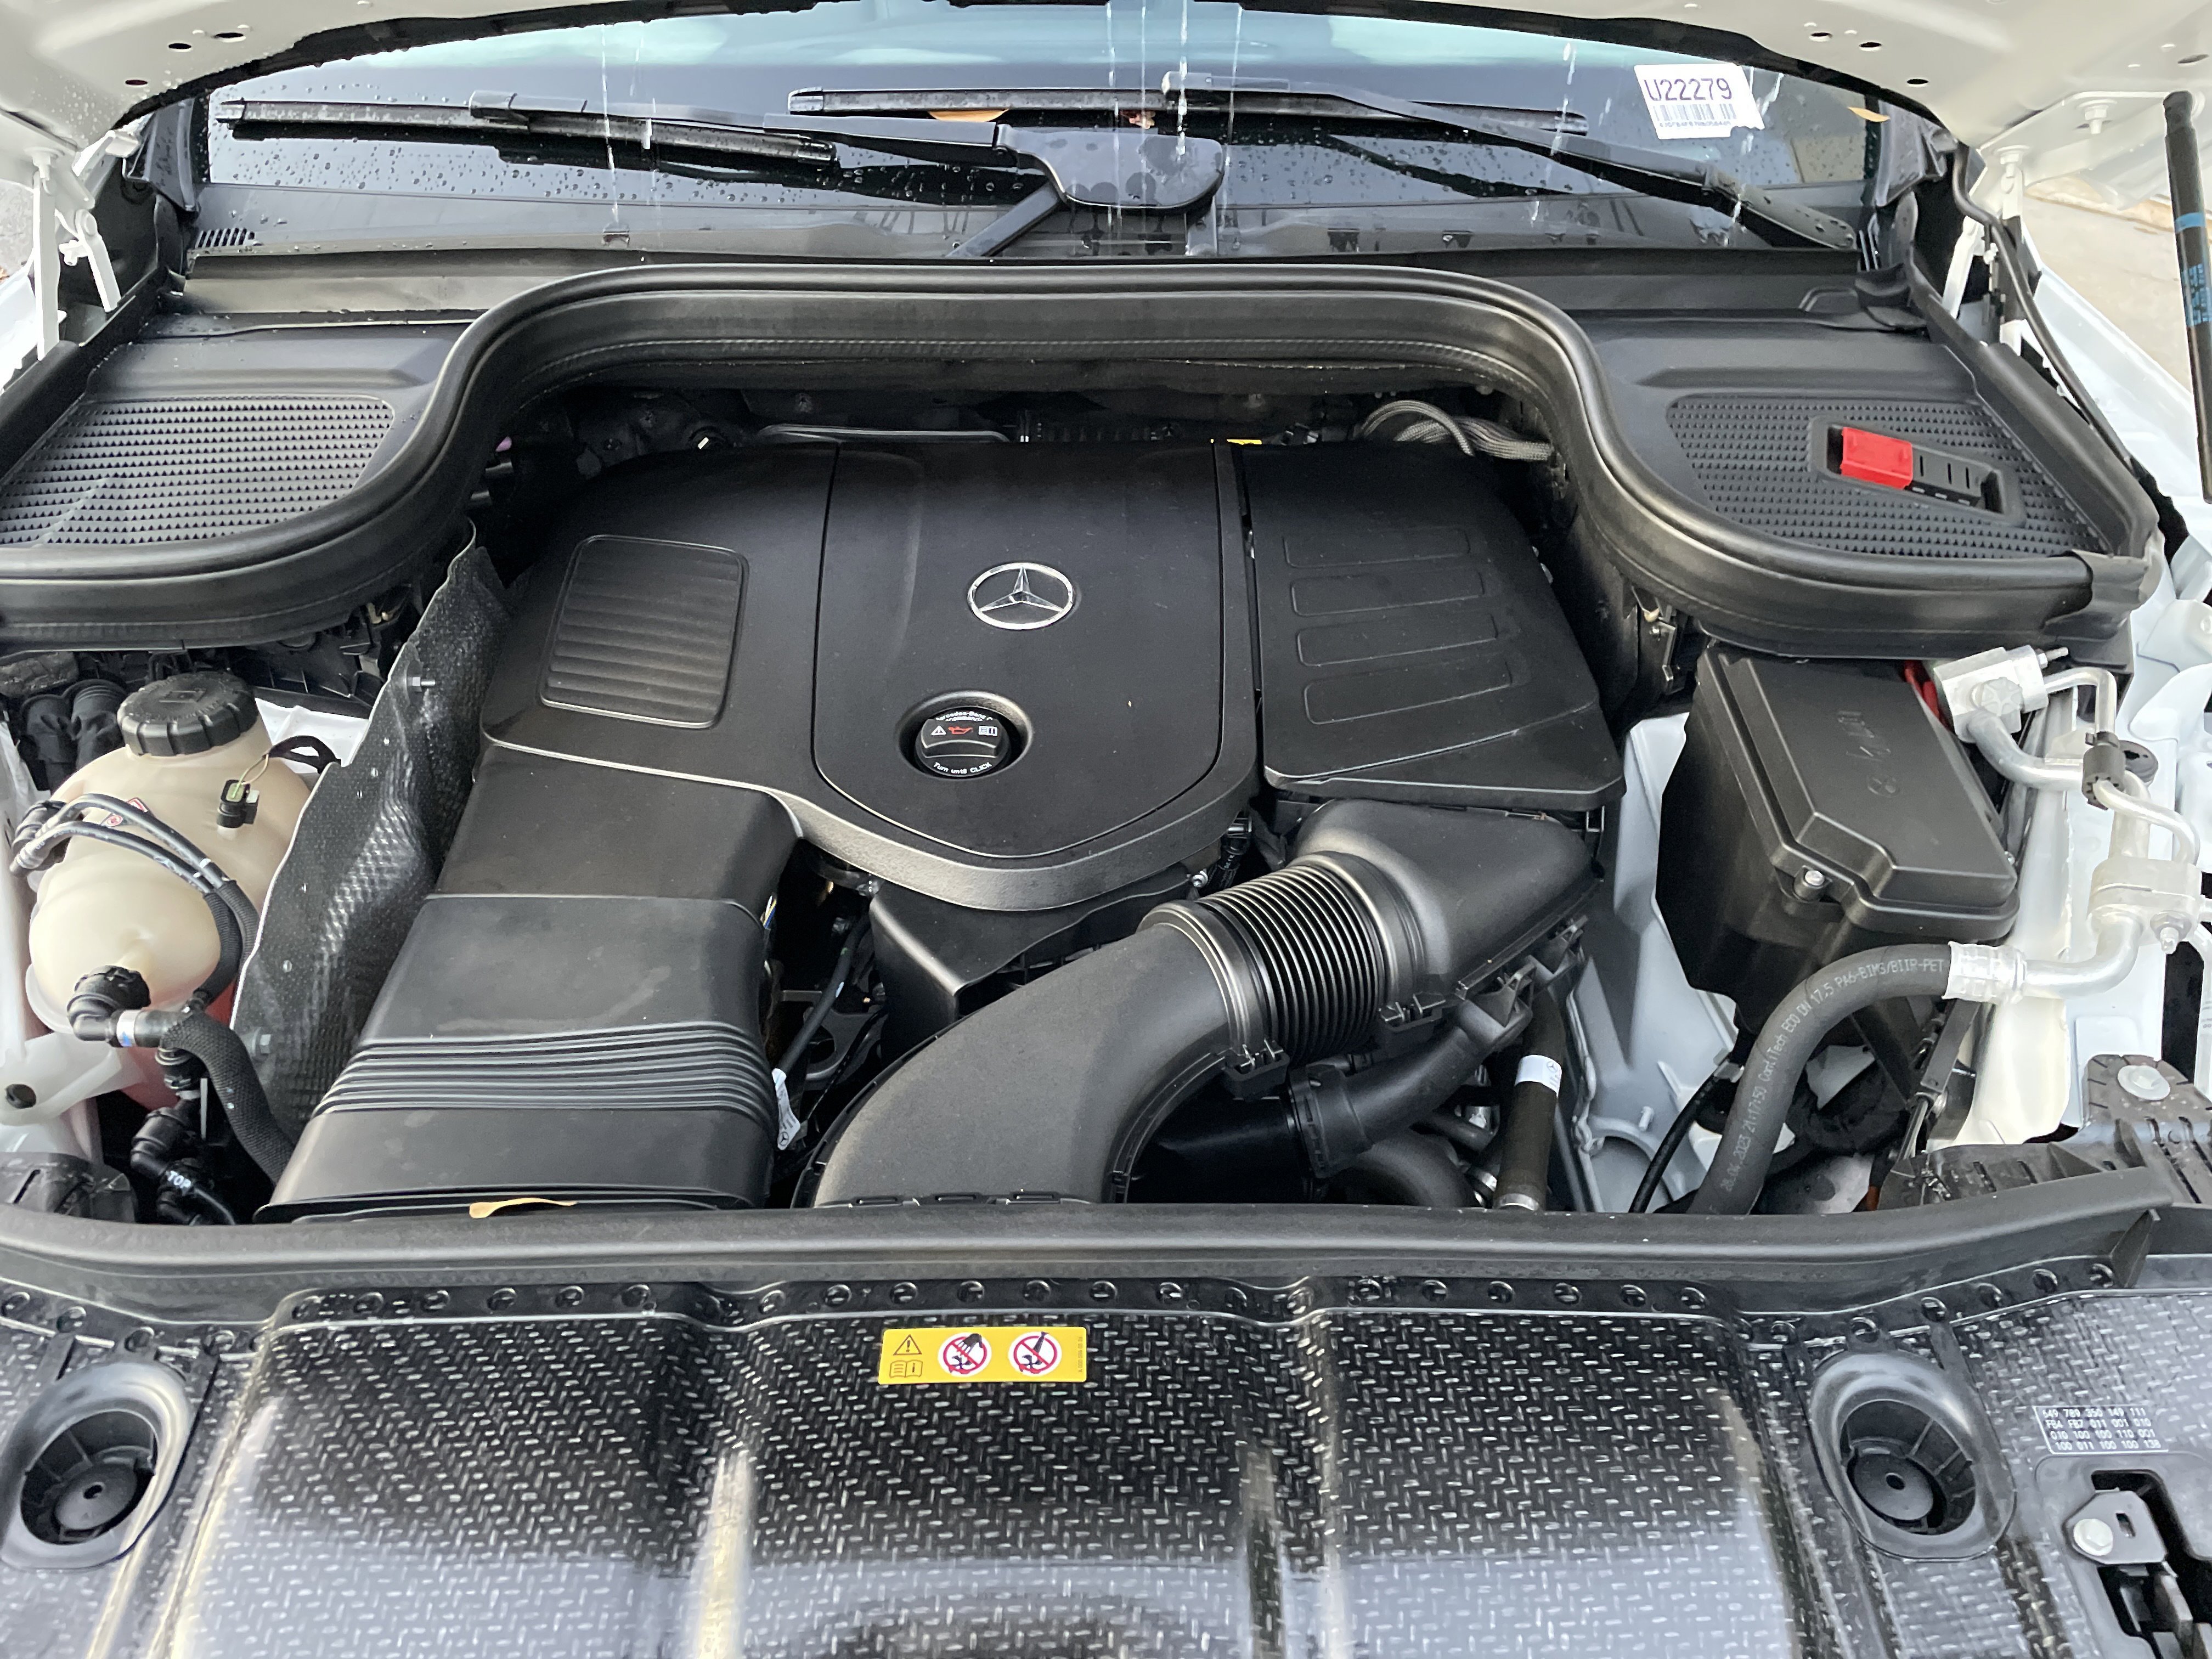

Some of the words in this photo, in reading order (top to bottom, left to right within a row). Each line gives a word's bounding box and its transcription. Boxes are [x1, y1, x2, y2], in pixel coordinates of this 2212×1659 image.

[1644, 78, 1732, 101] U22279
[933, 762, 949, 772] Turn
[970, 762, 992, 773] CLICK
[166, 1170, 191, 1189] TOP
[2130, 1408, 2146, 1416] 111
[2089, 1419, 2107, 1428] 011
[2111, 1418, 2129, 1427] 001
[2132, 1418, 2152, 1427] 010
[2050, 1431, 2068, 1440] 010
[2073, 1430, 2090, 1439] 100
[2095, 1430, 2112, 1439] 100
[2116, 1429, 2134, 1438] 110
[2137, 1429, 2155, 1437] 001
[2055, 1441, 2073, 1451] 100
[2076, 1441, 2095, 1450] 011
[2099, 1440, 2117, 1449] 100
[2121, 1440, 2139, 1449] 100
